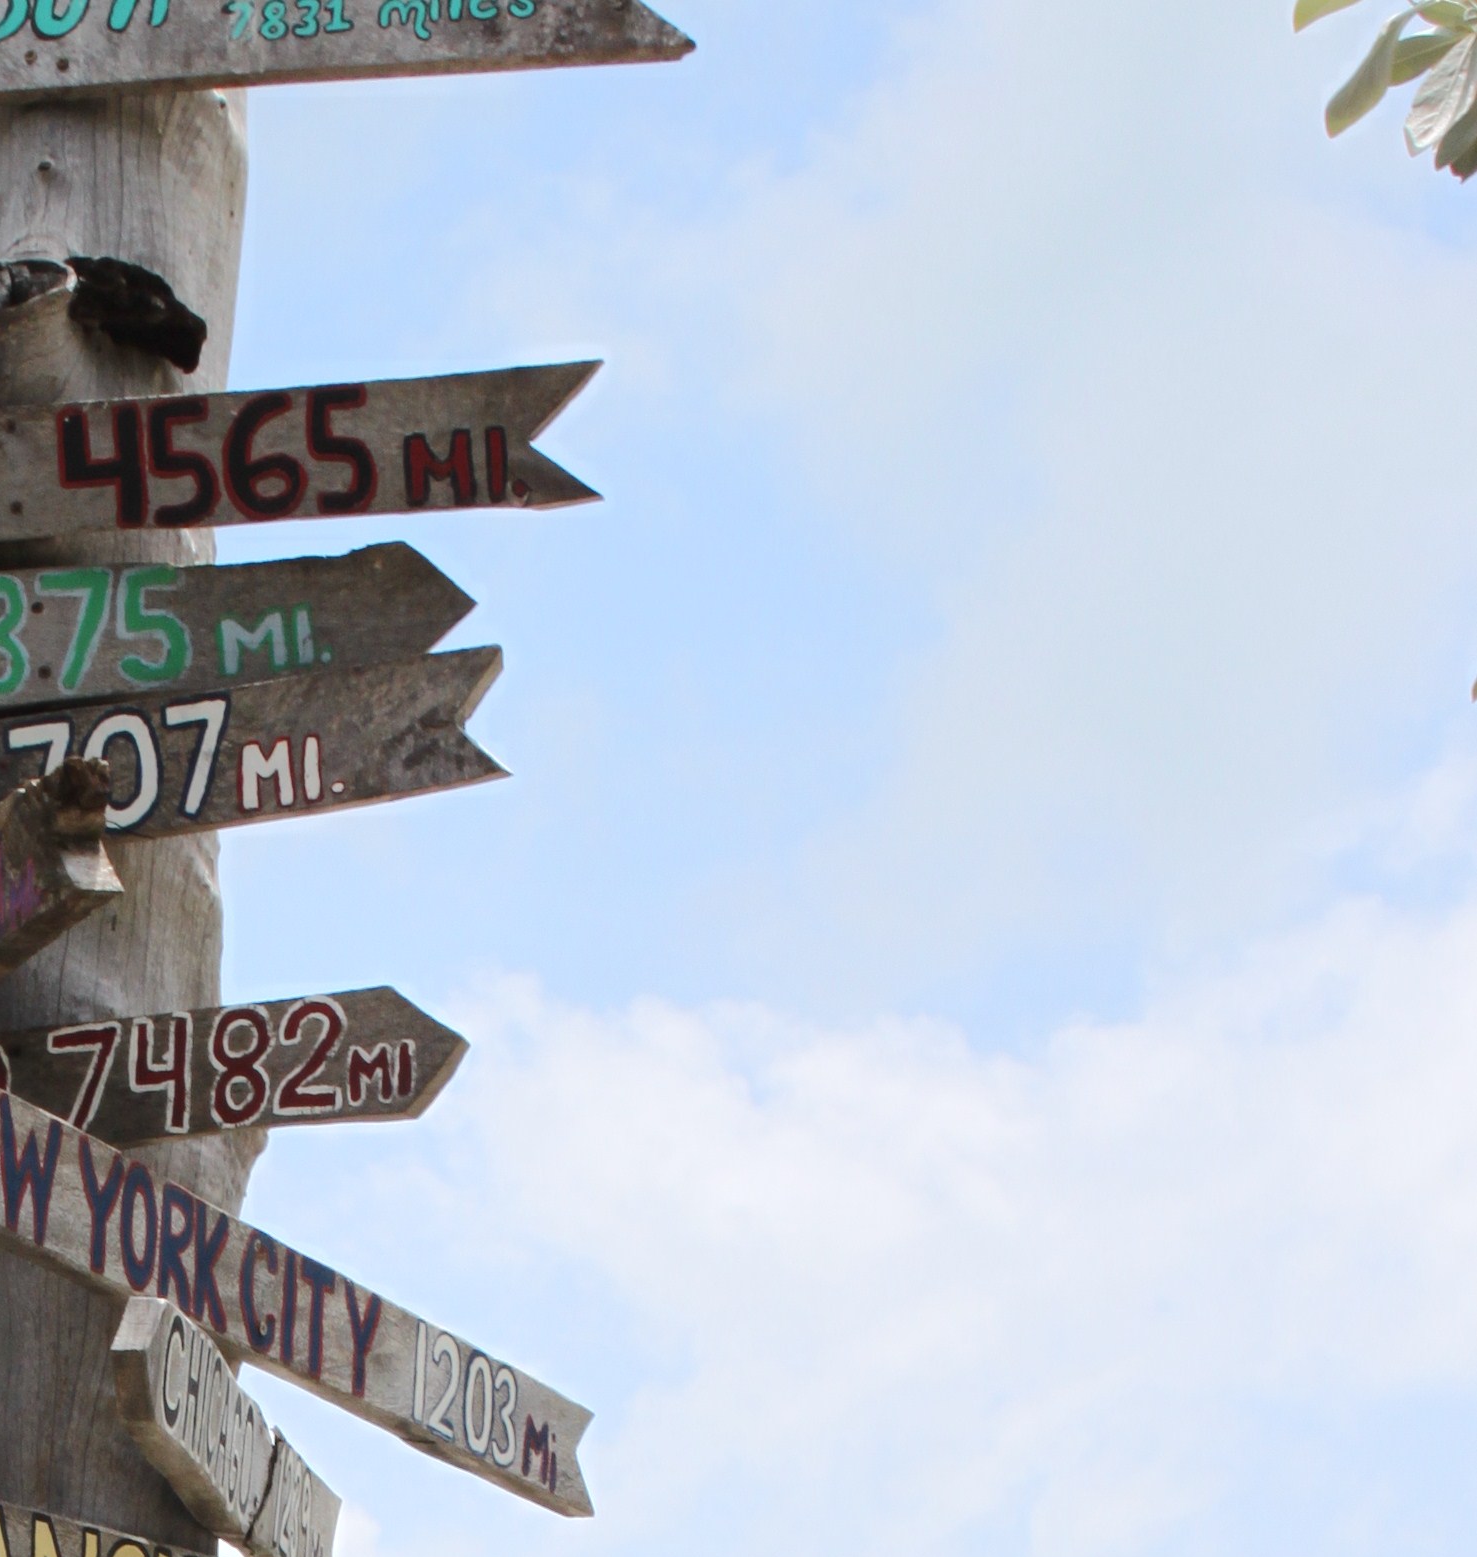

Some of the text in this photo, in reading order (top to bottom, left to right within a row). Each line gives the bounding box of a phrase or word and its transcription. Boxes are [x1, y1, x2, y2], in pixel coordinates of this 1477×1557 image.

[222, 0, 353, 41] 7831
[58, 386, 378, 528] 4565
[405, 424, 529, 510] MI.
[218, 609, 331, 677] MI.
[235, 736, 347, 815] MI.
[47, 994, 348, 1135] 7482
[349, 1037, 414, 1104] MI
[78, 1133, 228, 1336] YORK
[239, 1226, 384, 1400] CITY
[409, 1319, 521, 1470] 1203
